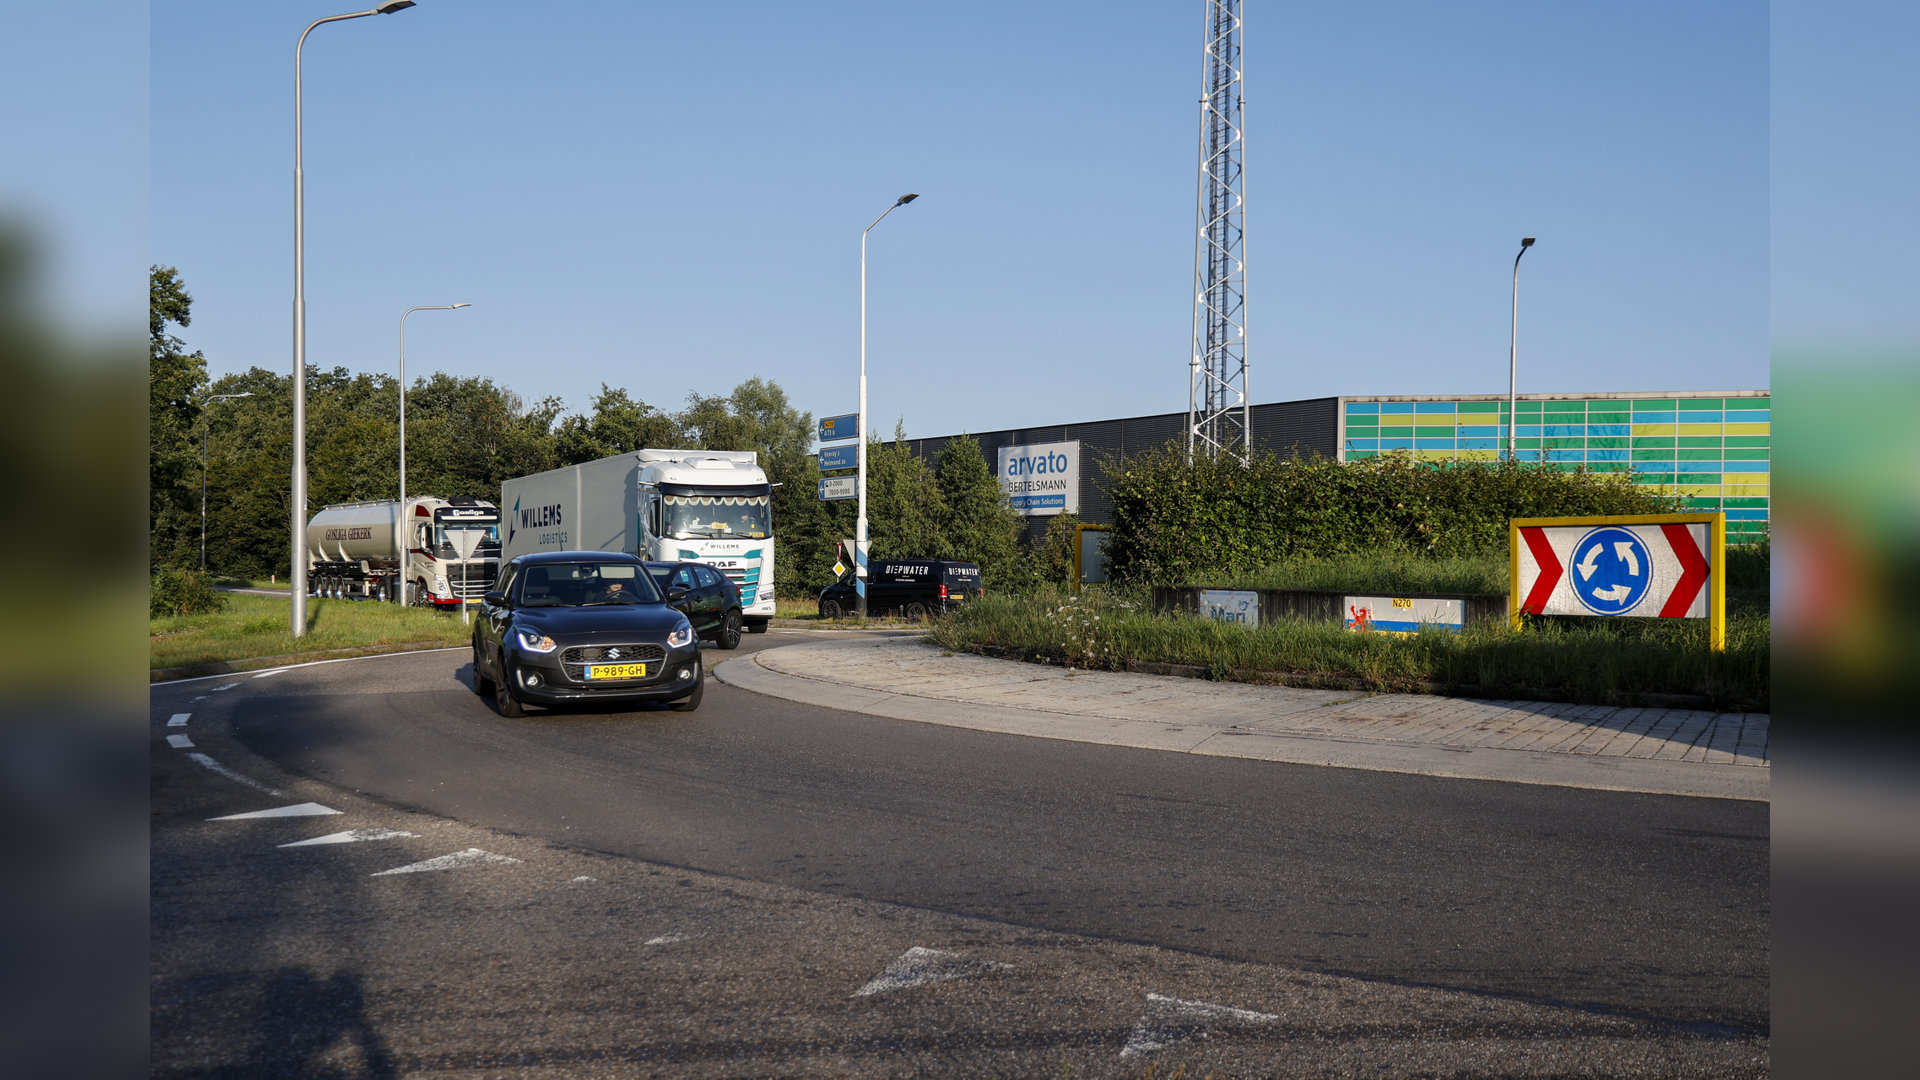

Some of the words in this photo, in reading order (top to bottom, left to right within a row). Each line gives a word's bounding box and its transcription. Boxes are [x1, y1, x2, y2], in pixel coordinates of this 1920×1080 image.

[824, 459, 840, 467] Helmond
[1008, 450, 1068, 476] arvato
[1008, 480, 1067, 492] BERTELSMANN
[1027, 498, 1040, 506] Chain
[1041, 497, 1064, 505] Solutions
[521, 503, 562, 529] WILLEMS
[325, 528, 347, 541] GOSLIGA
[347, 527, 372, 540] GIEKERK
[539, 531, 568, 545] LOGISTICS
[885, 565, 929, 575] DIEPWATER
[948, 567, 978, 576] DIEPWATER
[1392, 599, 1411, 608] N270
[593, 665, 643, 677] P-989-GH
